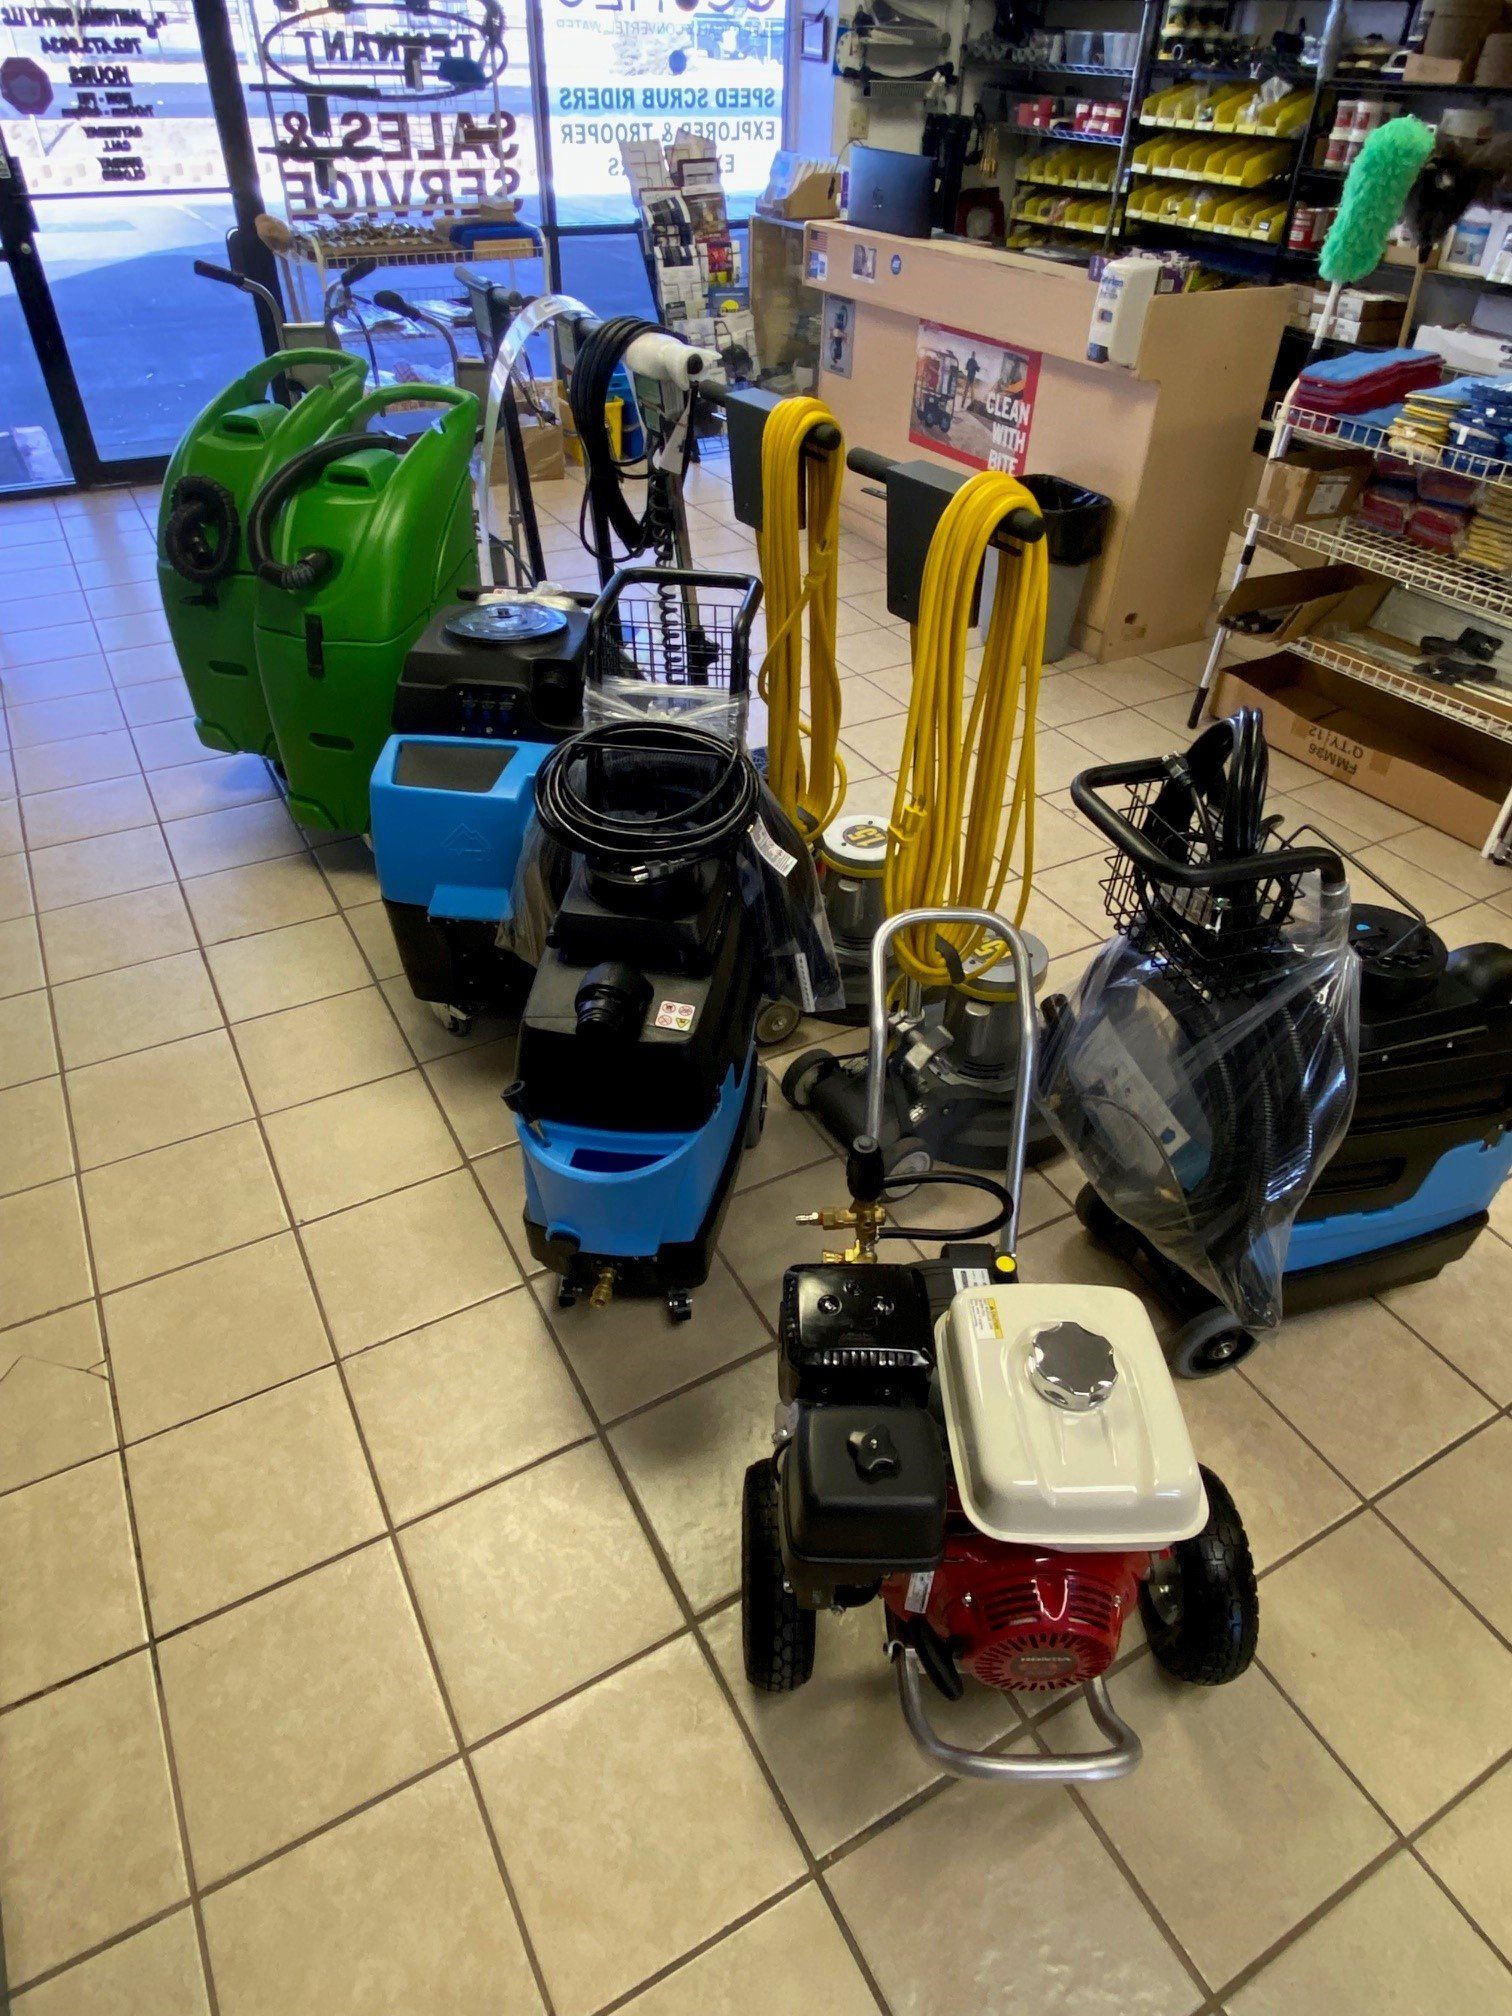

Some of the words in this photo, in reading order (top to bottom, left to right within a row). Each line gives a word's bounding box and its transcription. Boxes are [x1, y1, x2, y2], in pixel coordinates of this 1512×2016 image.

[986, 390, 1031, 426] CLEAN
[992, 421, 1027, 454] WITH
[988, 448, 1019, 475] BITE
